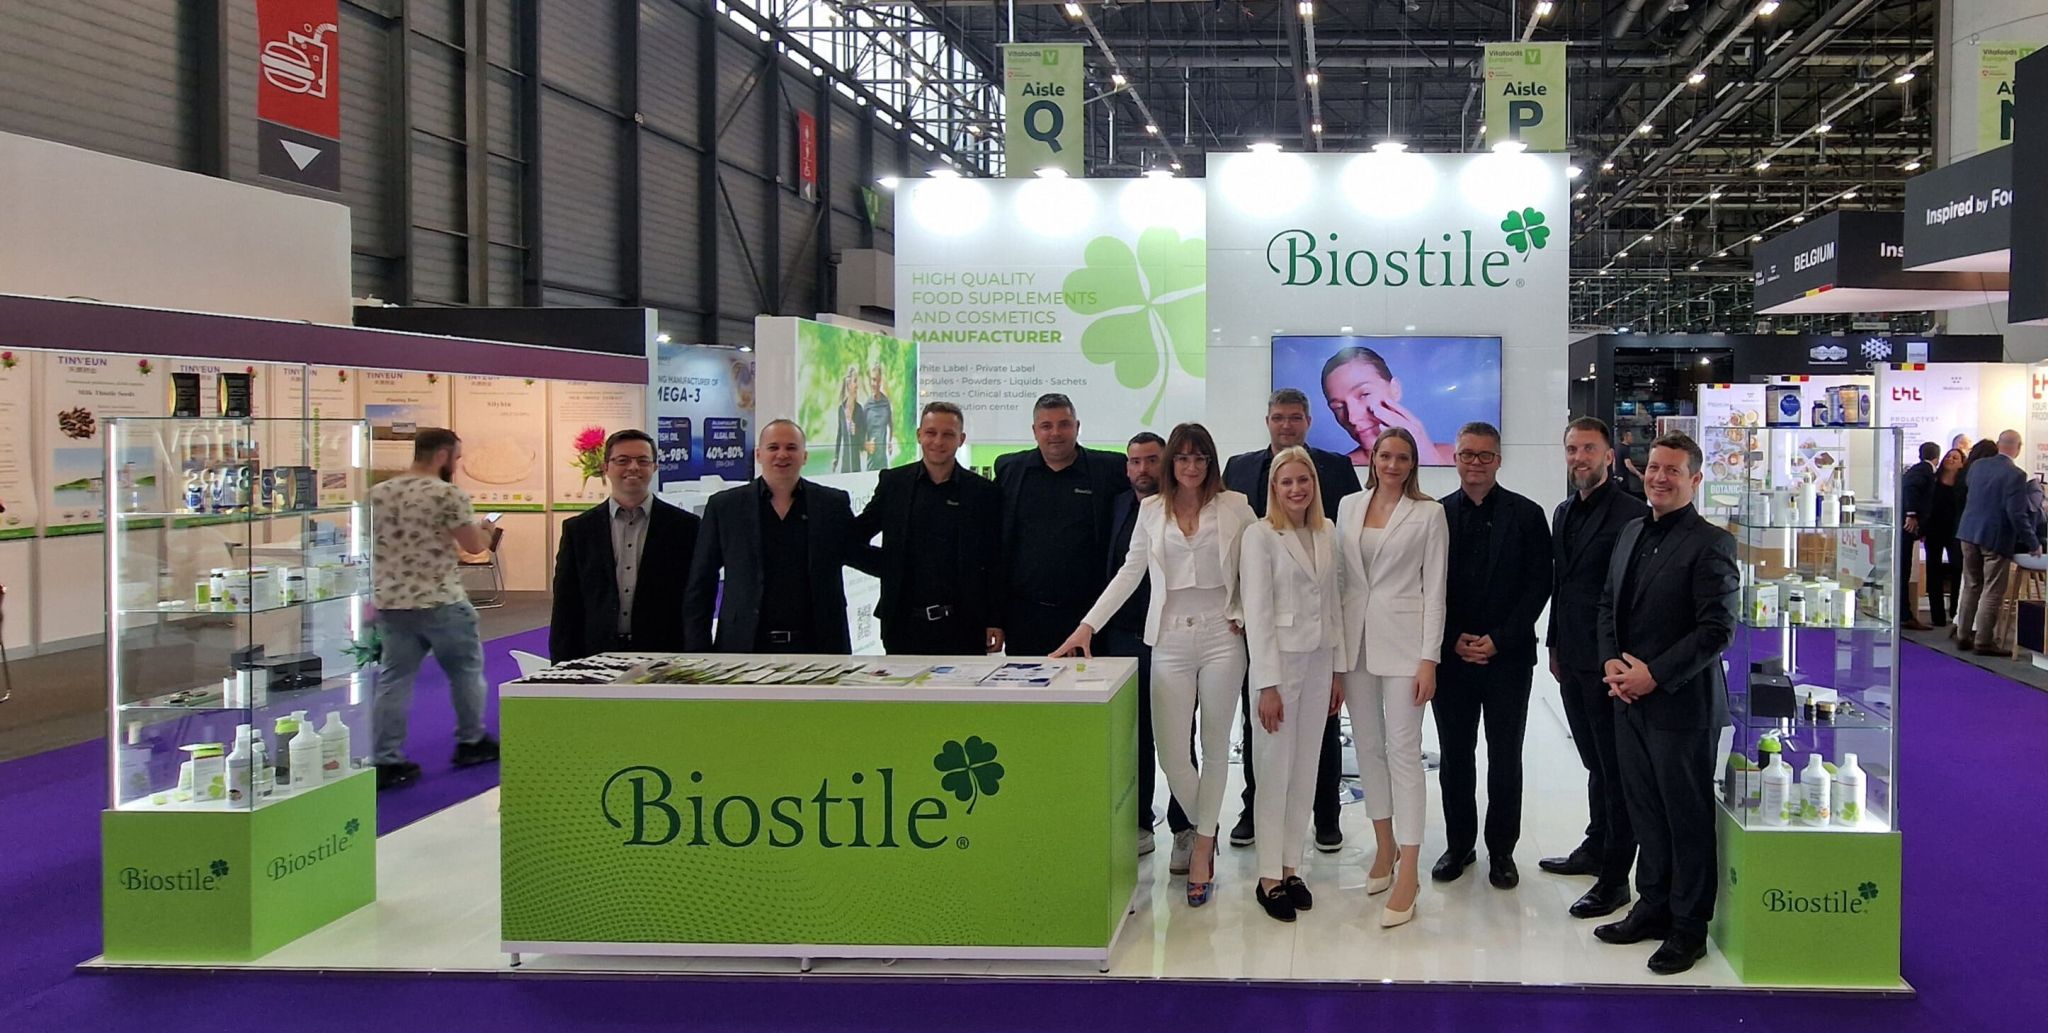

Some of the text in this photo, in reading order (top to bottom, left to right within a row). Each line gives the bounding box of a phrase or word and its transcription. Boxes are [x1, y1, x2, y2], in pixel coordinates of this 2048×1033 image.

[1007, 49, 1041, 57] Vitafoods
[1022, 82, 1065, 97] Aisle
[1502, 81, 1547, 96] Aisle
[1023, 100, 1064, 153] Q
[1509, 100, 1544, 141] P
[1925, 194, 1974, 226] Inspired
[1975, 198, 1989, 214] by
[1794, 241, 1835, 273] BELGIUM
[912, 272, 1035, 288] HIGH QUALITY
[912, 291, 1097, 305] FOOD SUPPLEMENTS
[911, 310, 1056, 324] AND COSMETICS
[912, 330, 1062, 343] MANUFACTURER
[919, 364, 1035, 373] hite Label Private Label
[668, 376, 710, 386] MANUFACTURER
[919, 377, 1088, 387] apsules Powders Liquids Sachets
[967, 390, 1002, 398] Clinical
[1003, 390, 1037, 398] studies
[1892, 386, 1923, 401] tht
[713, 431, 737, 440] ALGAL OIL
[706, 445, 744, 461] 40%-80%
